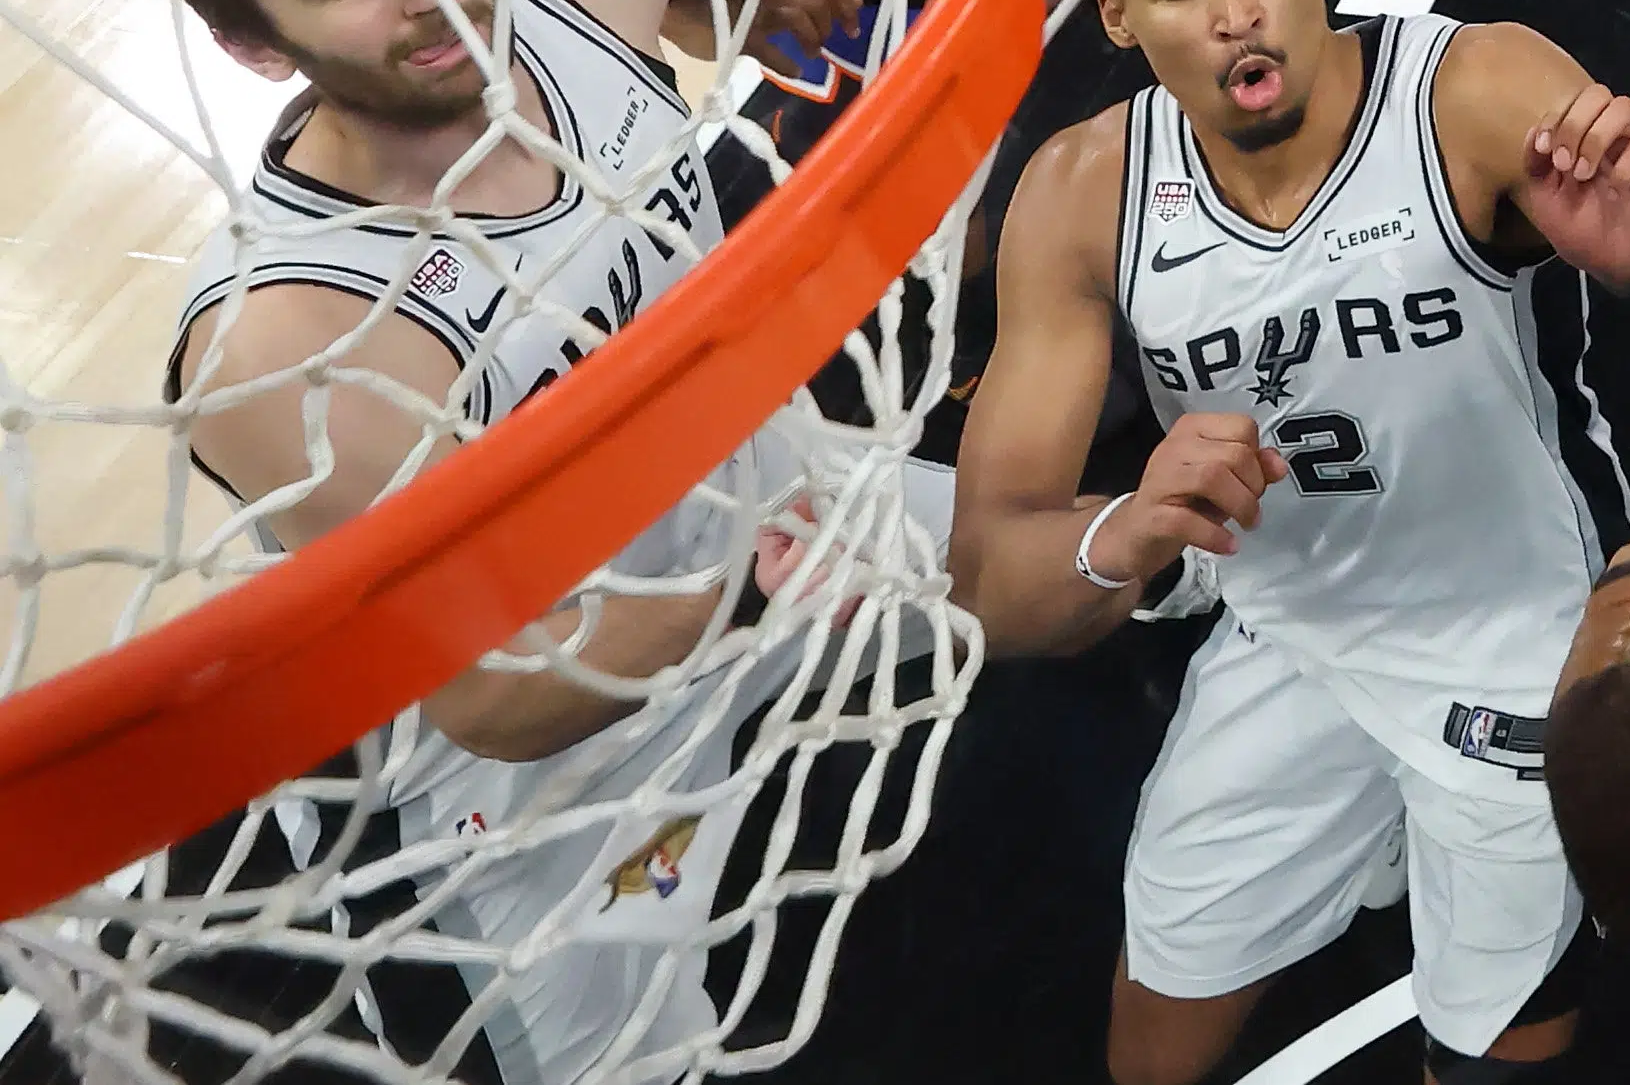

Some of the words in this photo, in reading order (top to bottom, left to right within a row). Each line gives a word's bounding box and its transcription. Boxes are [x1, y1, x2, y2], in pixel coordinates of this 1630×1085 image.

[611, 101, 639, 156] LEDGER
[1157, 184, 1189, 195] USA
[1151, 202, 1189, 215] 250
[1337, 220, 1402, 250] LEDGER
[412, 254, 448, 285] USA
[1142, 287, 1464, 408] SPURS
[1273, 410, 1384, 497] 2
